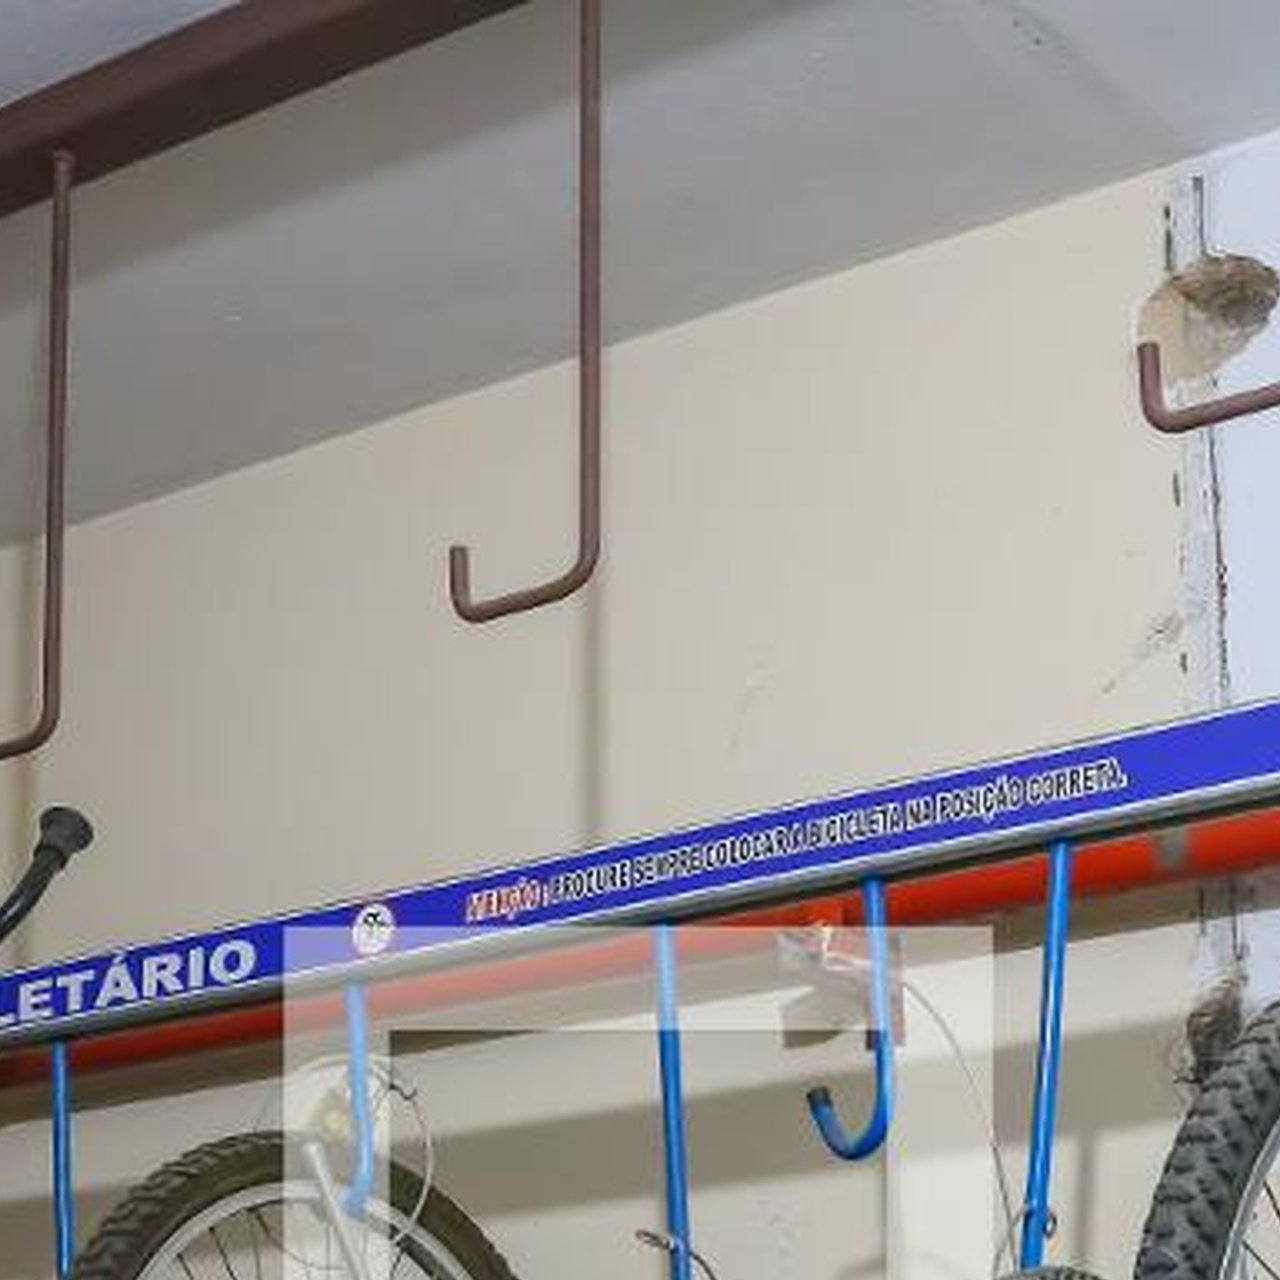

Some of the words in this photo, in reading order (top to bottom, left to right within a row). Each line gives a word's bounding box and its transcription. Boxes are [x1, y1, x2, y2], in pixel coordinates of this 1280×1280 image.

[551, 859, 630, 905] PROCURE
[631, 845, 701, 889] SEMPRE
[804, 801, 903, 851] BICICLETA
[904, 795, 936, 832] NA
[936, 773, 1023, 825] POSIÇÃO
